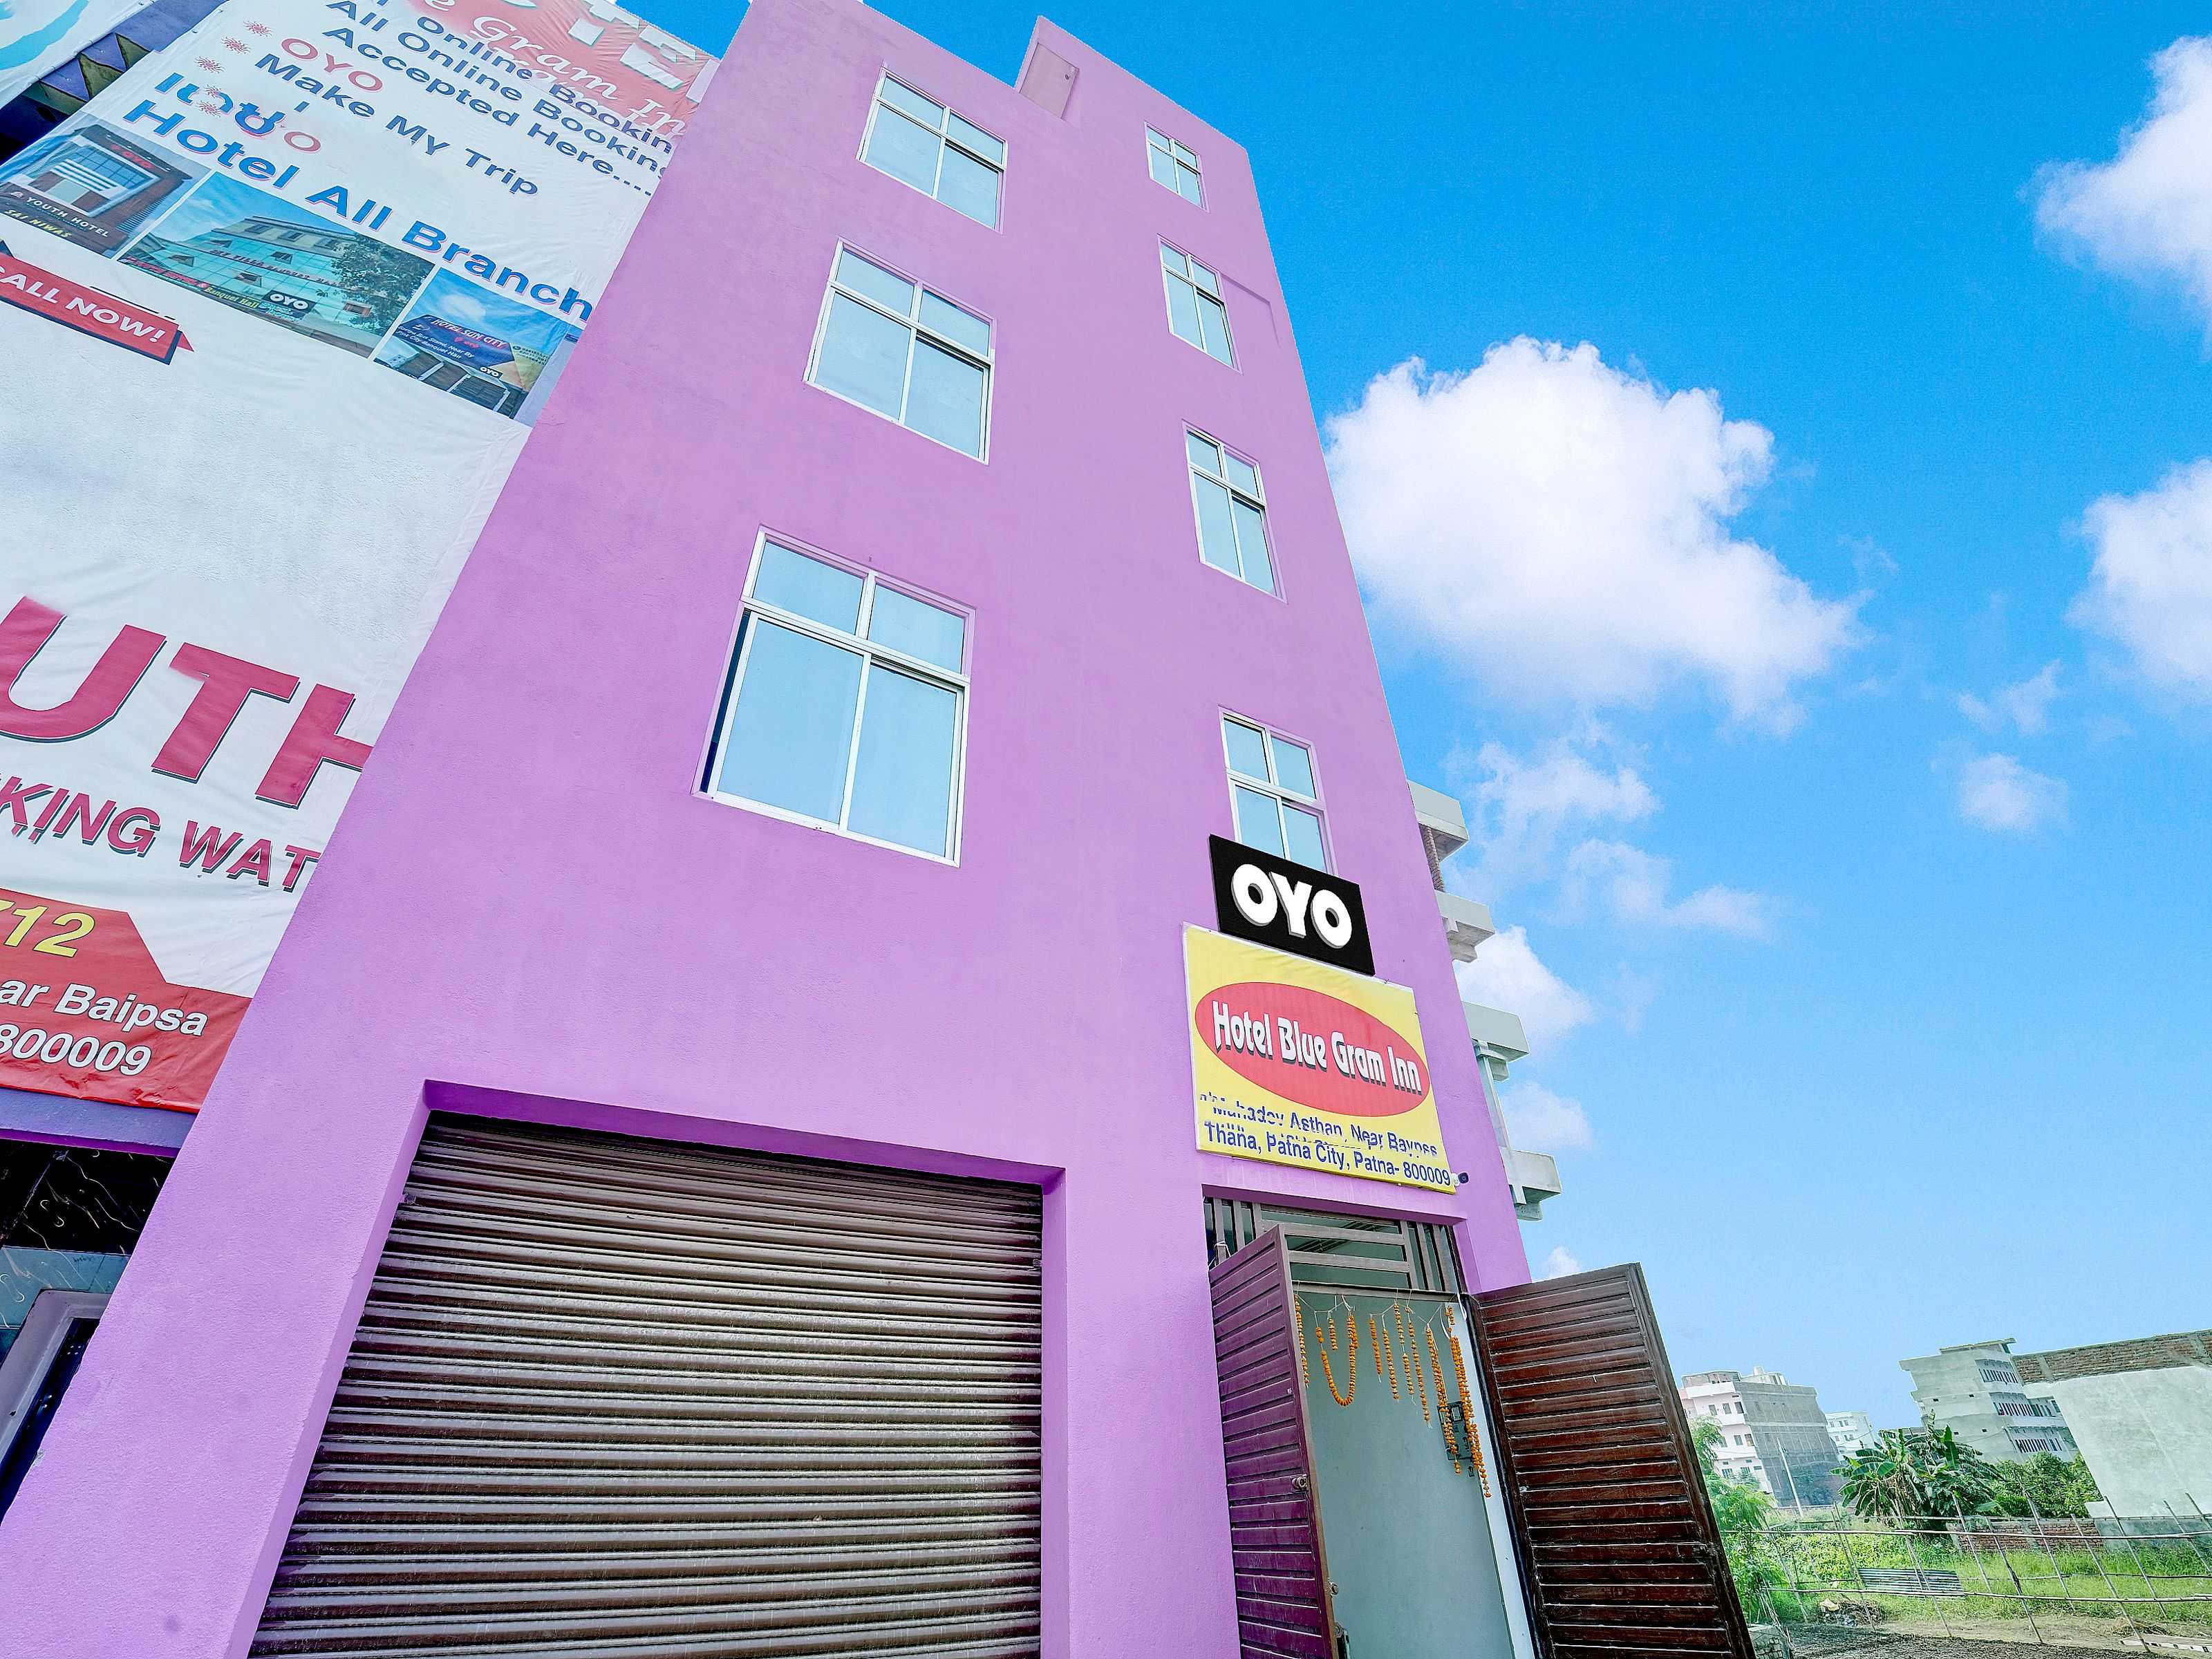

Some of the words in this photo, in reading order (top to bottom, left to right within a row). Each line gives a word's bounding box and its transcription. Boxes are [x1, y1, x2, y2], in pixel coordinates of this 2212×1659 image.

[281, 38, 383, 91] OYO
[326, 1, 388, 32] All
[397, 32, 522, 101] Online
[417, 17, 532, 79] Online
[321, 28, 519, 126] Accepted
[254, 53, 375, 118] Make
[464, 148, 538, 197] Trip
[26, 197, 68, 218] YOUTH
[71, 217, 111, 237] HOTEL
[123, 99, 301, 189] Hotel
[305, 185, 393, 232] All
[401, 220, 594, 322] Branch
[66, 297, 167, 344] NOW!
[270, 293, 308, 310] OYO
[431, 319, 462, 332] HOTEL
[462, 329, 482, 341] SUN
[483, 337, 507, 349] CITY
[480, 366, 499, 377] OYO
[1230, 863, 1352, 948] OYO
[54, 982, 209, 1036] Baipsa
[0, 1023, 152, 1076] 800009
[1212, 1000, 1273, 1060] Hotel
[1277, 1017, 1327, 1072] Blue
[1331, 1031, 1387, 1087] Gram
[1387, 1045, 1423, 1096] Inn
[1204, 1121, 1262, 1154] Thana,
[1266, 1132, 1311, 1159] Patna
[1315, 1143, 1350, 1170] City,
[1403, 1161, 1451, 1186] 800009
[1351, 1125, 1383, 1150] Near
